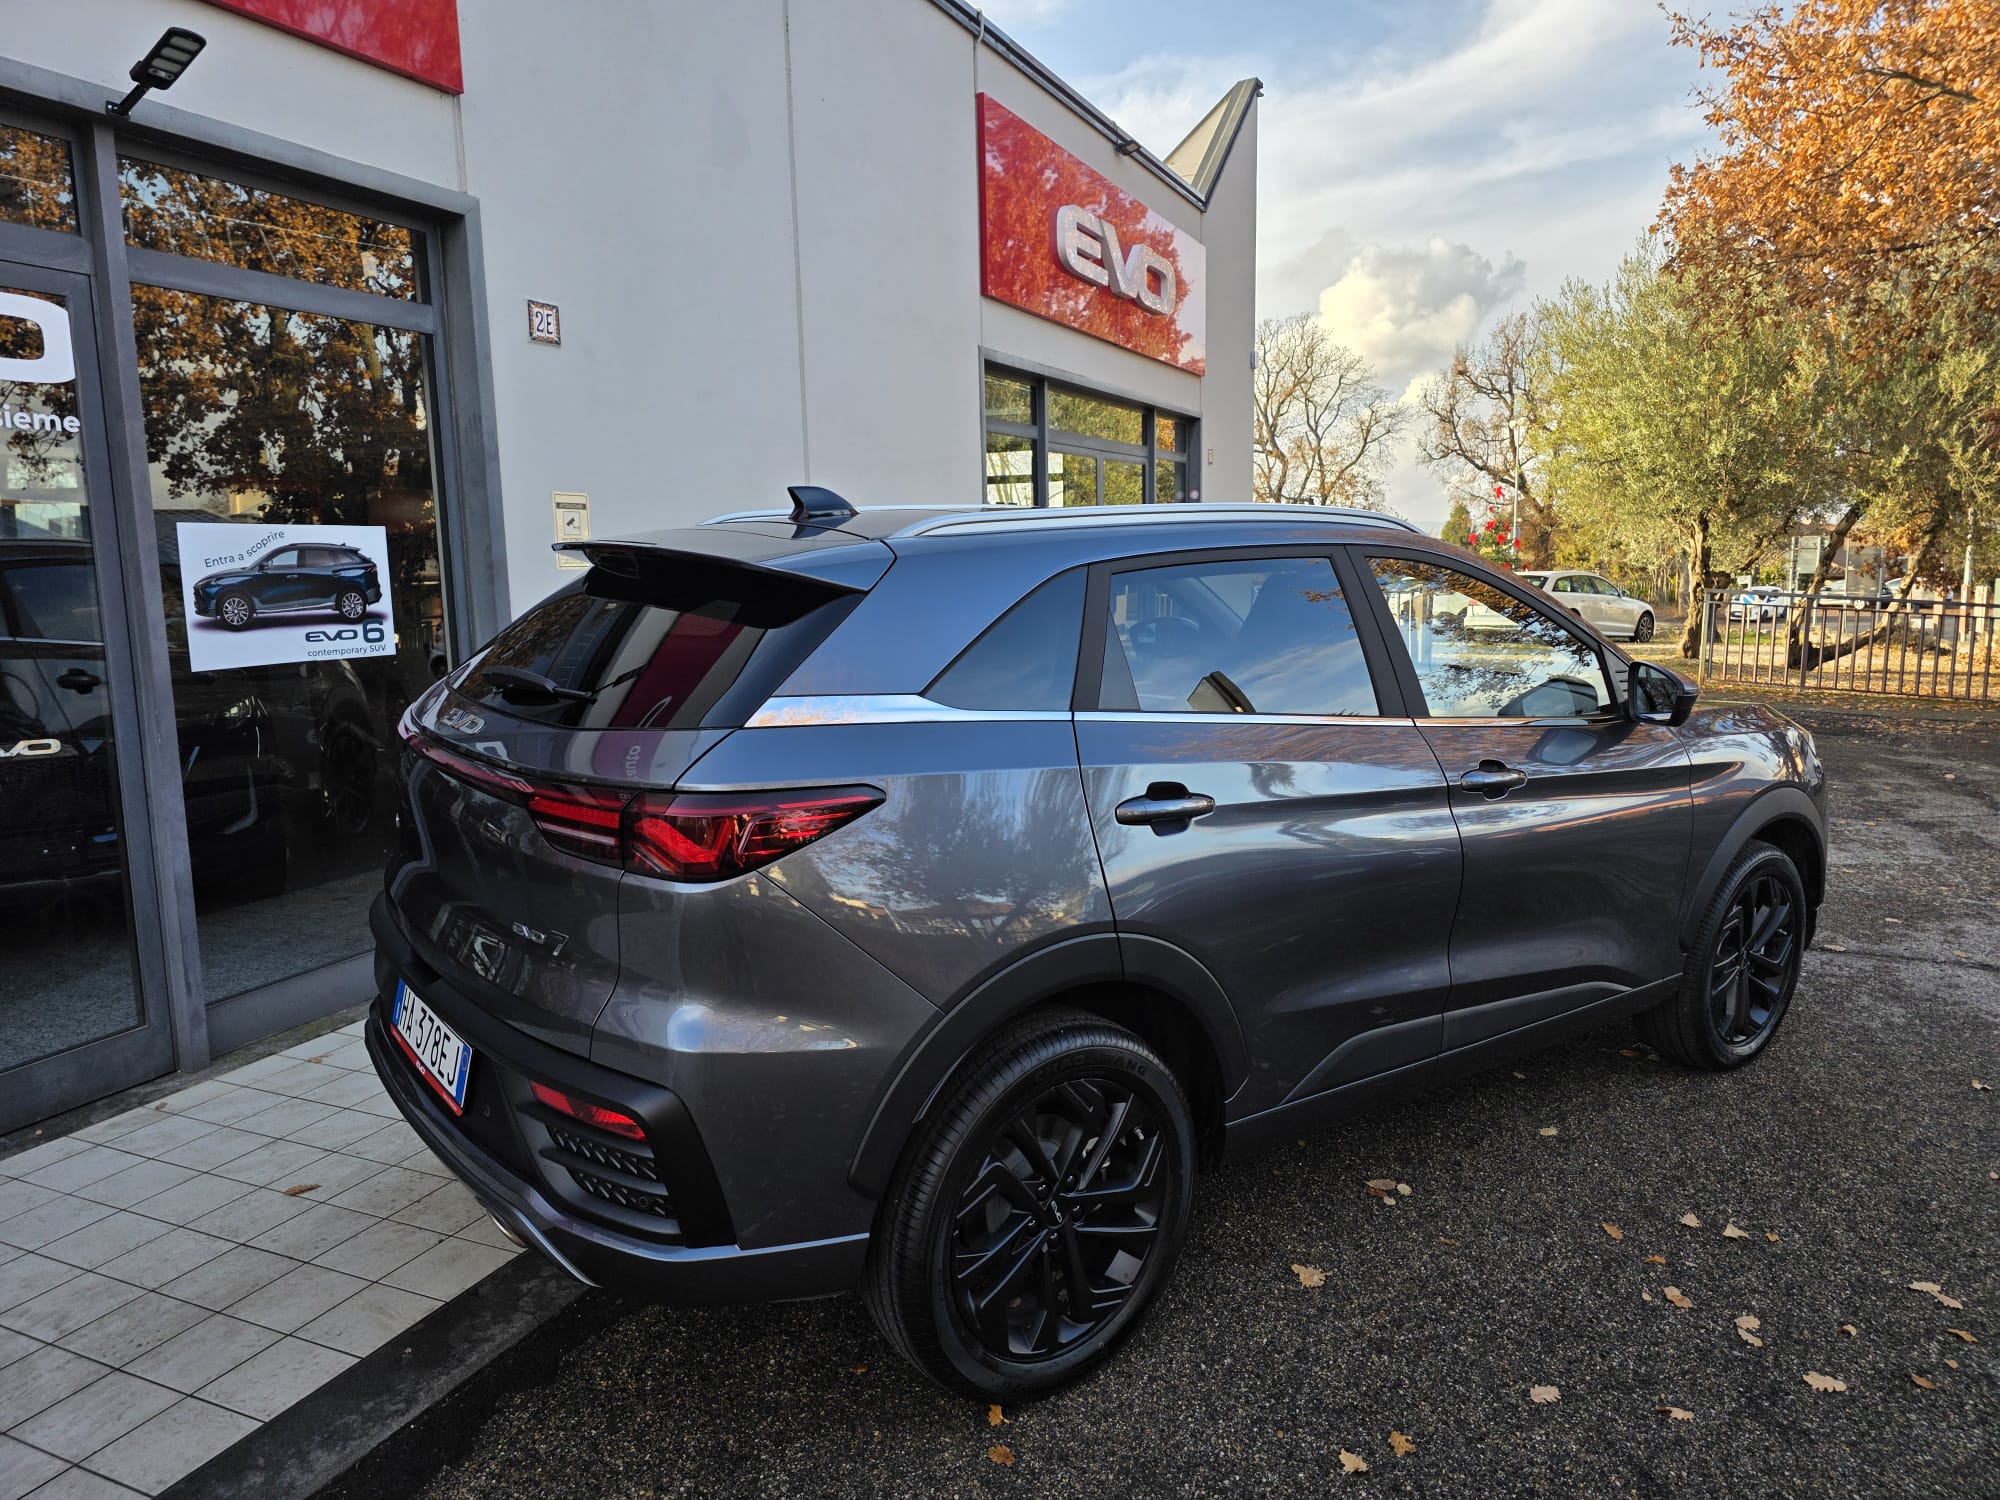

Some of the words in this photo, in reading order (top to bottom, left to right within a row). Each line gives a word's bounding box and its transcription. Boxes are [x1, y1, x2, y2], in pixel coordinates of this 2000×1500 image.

[1054, 204, 1176, 316] EVO
[535, 311, 554, 335] 2E
[0, 403, 81, 433] ieme
[204, 554, 236, 568] Entra
[237, 553, 245, 561] a
[246, 531, 286, 557] scoprire
[305, 629, 358, 643] EVO
[362, 618, 385, 644] 6
[307, 646, 368, 657] contemporary
[369, 644, 386, 653] SUV
[440, 707, 486, 735] EVO
[550, 929, 570, 957] 7
[399, 988, 416, 1038] HA
[416, 1005, 460, 1087] 378EJ
